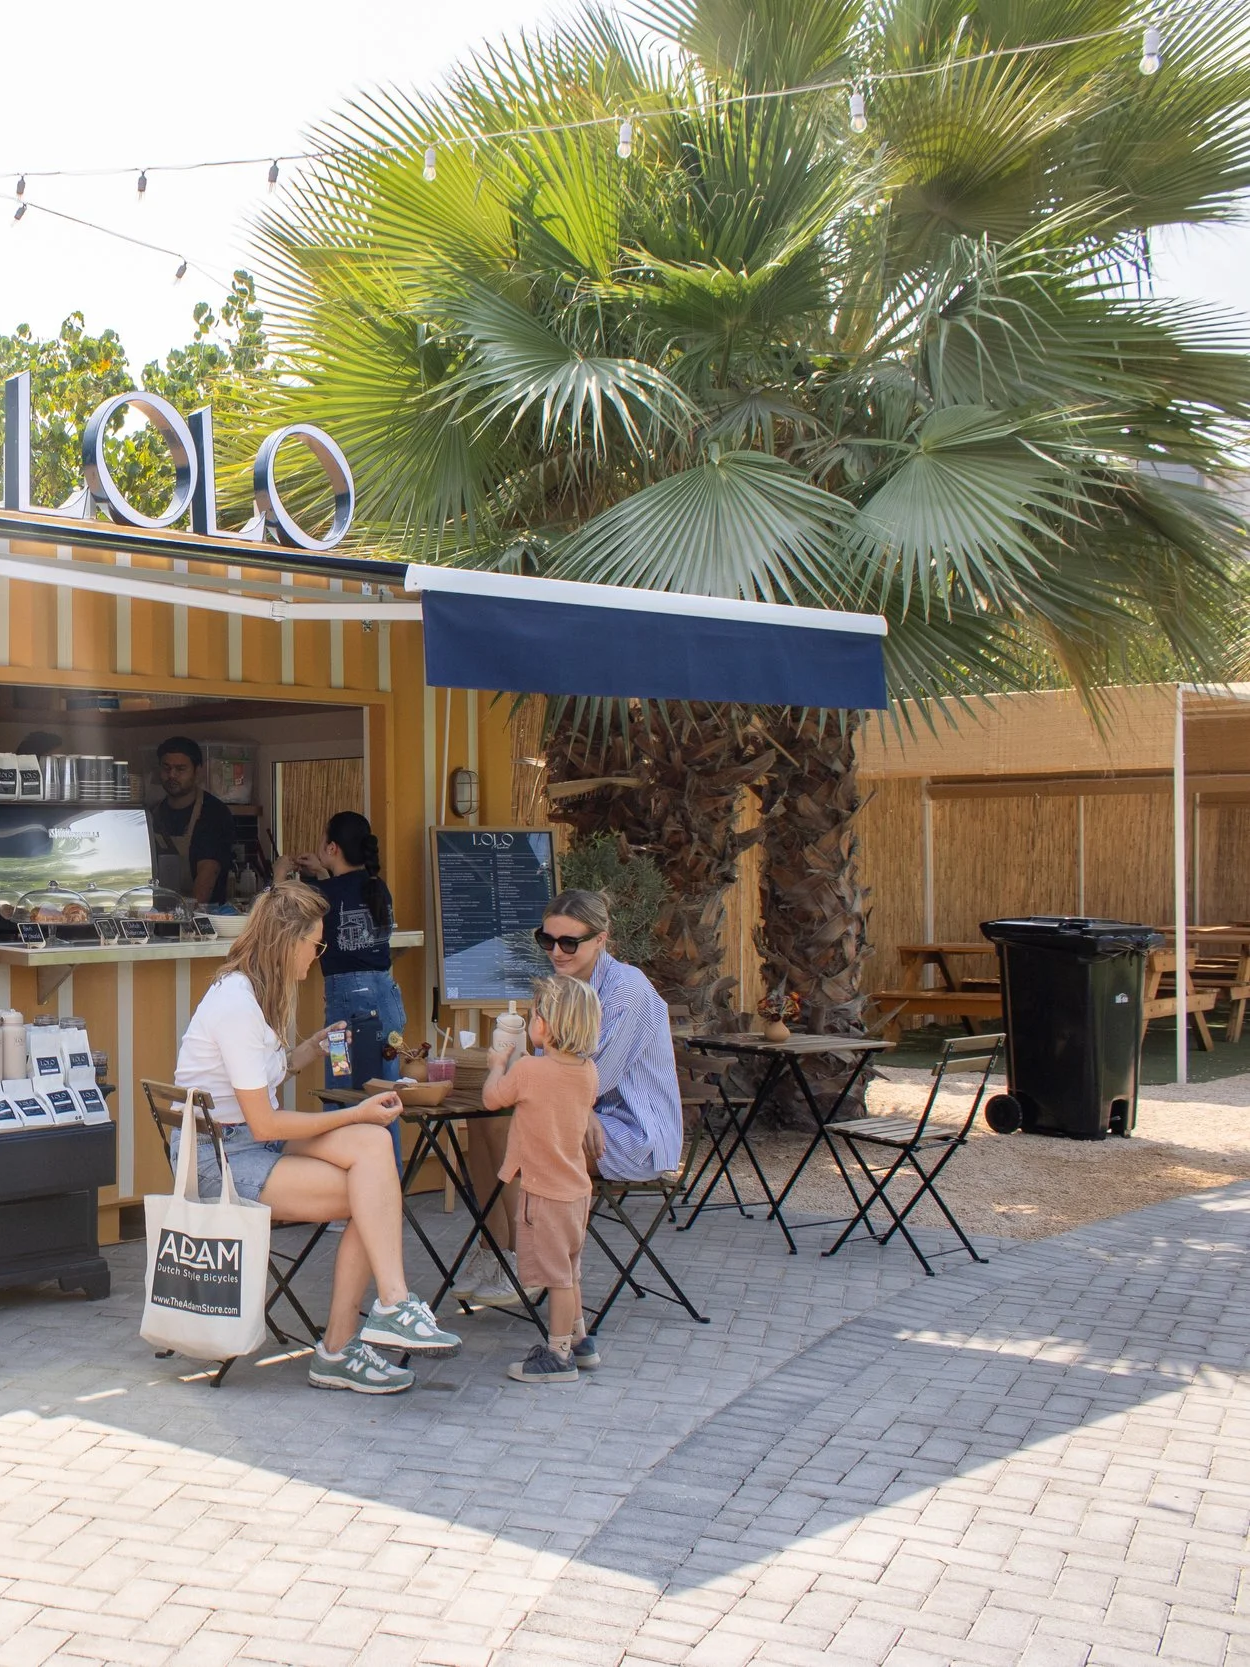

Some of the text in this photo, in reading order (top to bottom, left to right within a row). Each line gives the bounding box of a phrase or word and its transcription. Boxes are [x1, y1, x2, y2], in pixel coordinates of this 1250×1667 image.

[4, 369, 355, 551] LOLO
[472, 833, 514, 846] LOLO
[51, 1092, 66, 1100] LOLO
[159, 1232, 239, 1271] ADAM
[157, 1262, 239, 1284] Dutch Style Bicycles
[153, 1294, 238, 1315] www.TheAdamStore.com
[396, 1310, 415, 1326] N
[345, 1358, 365, 1373] N
